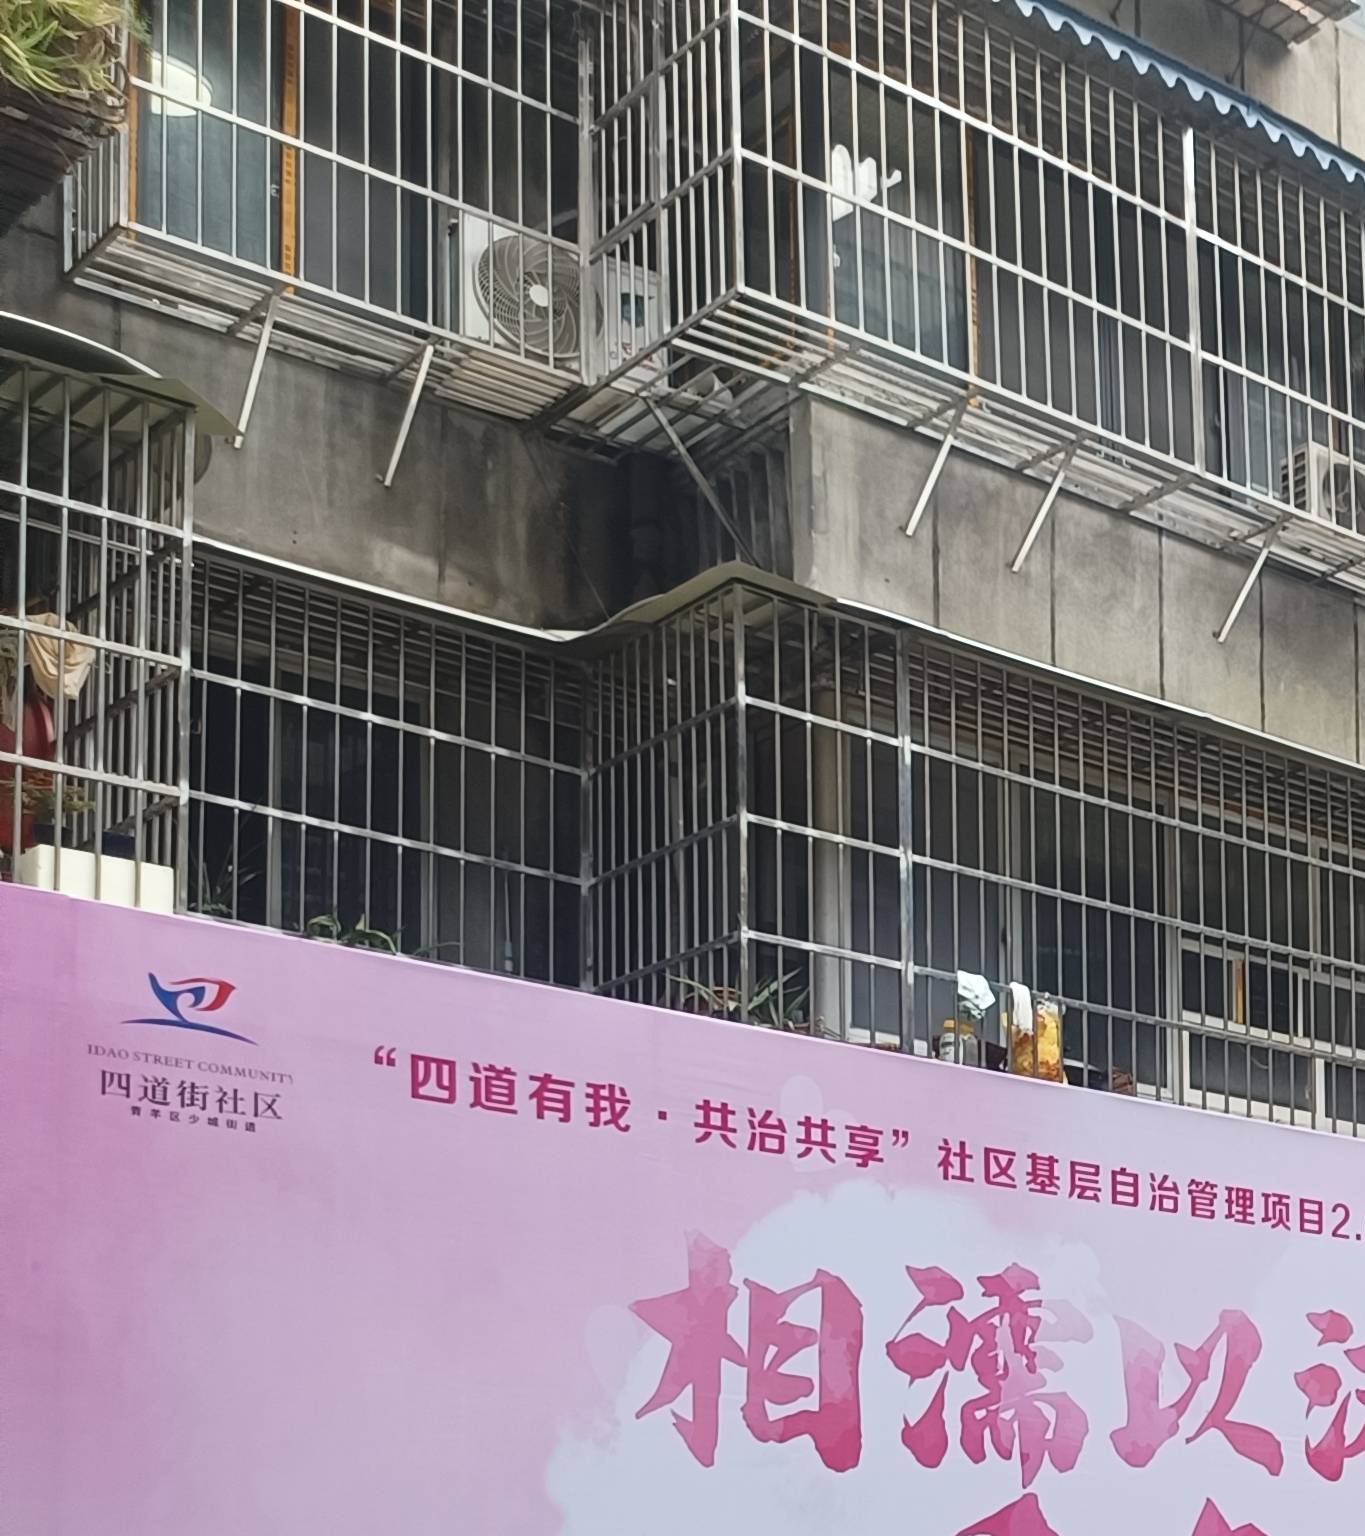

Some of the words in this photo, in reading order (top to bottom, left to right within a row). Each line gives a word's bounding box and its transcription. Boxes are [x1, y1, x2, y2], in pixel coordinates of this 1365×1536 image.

[133, 1051, 195, 1070] STREET
[101, 1069, 284, 1120] 四道街社区
